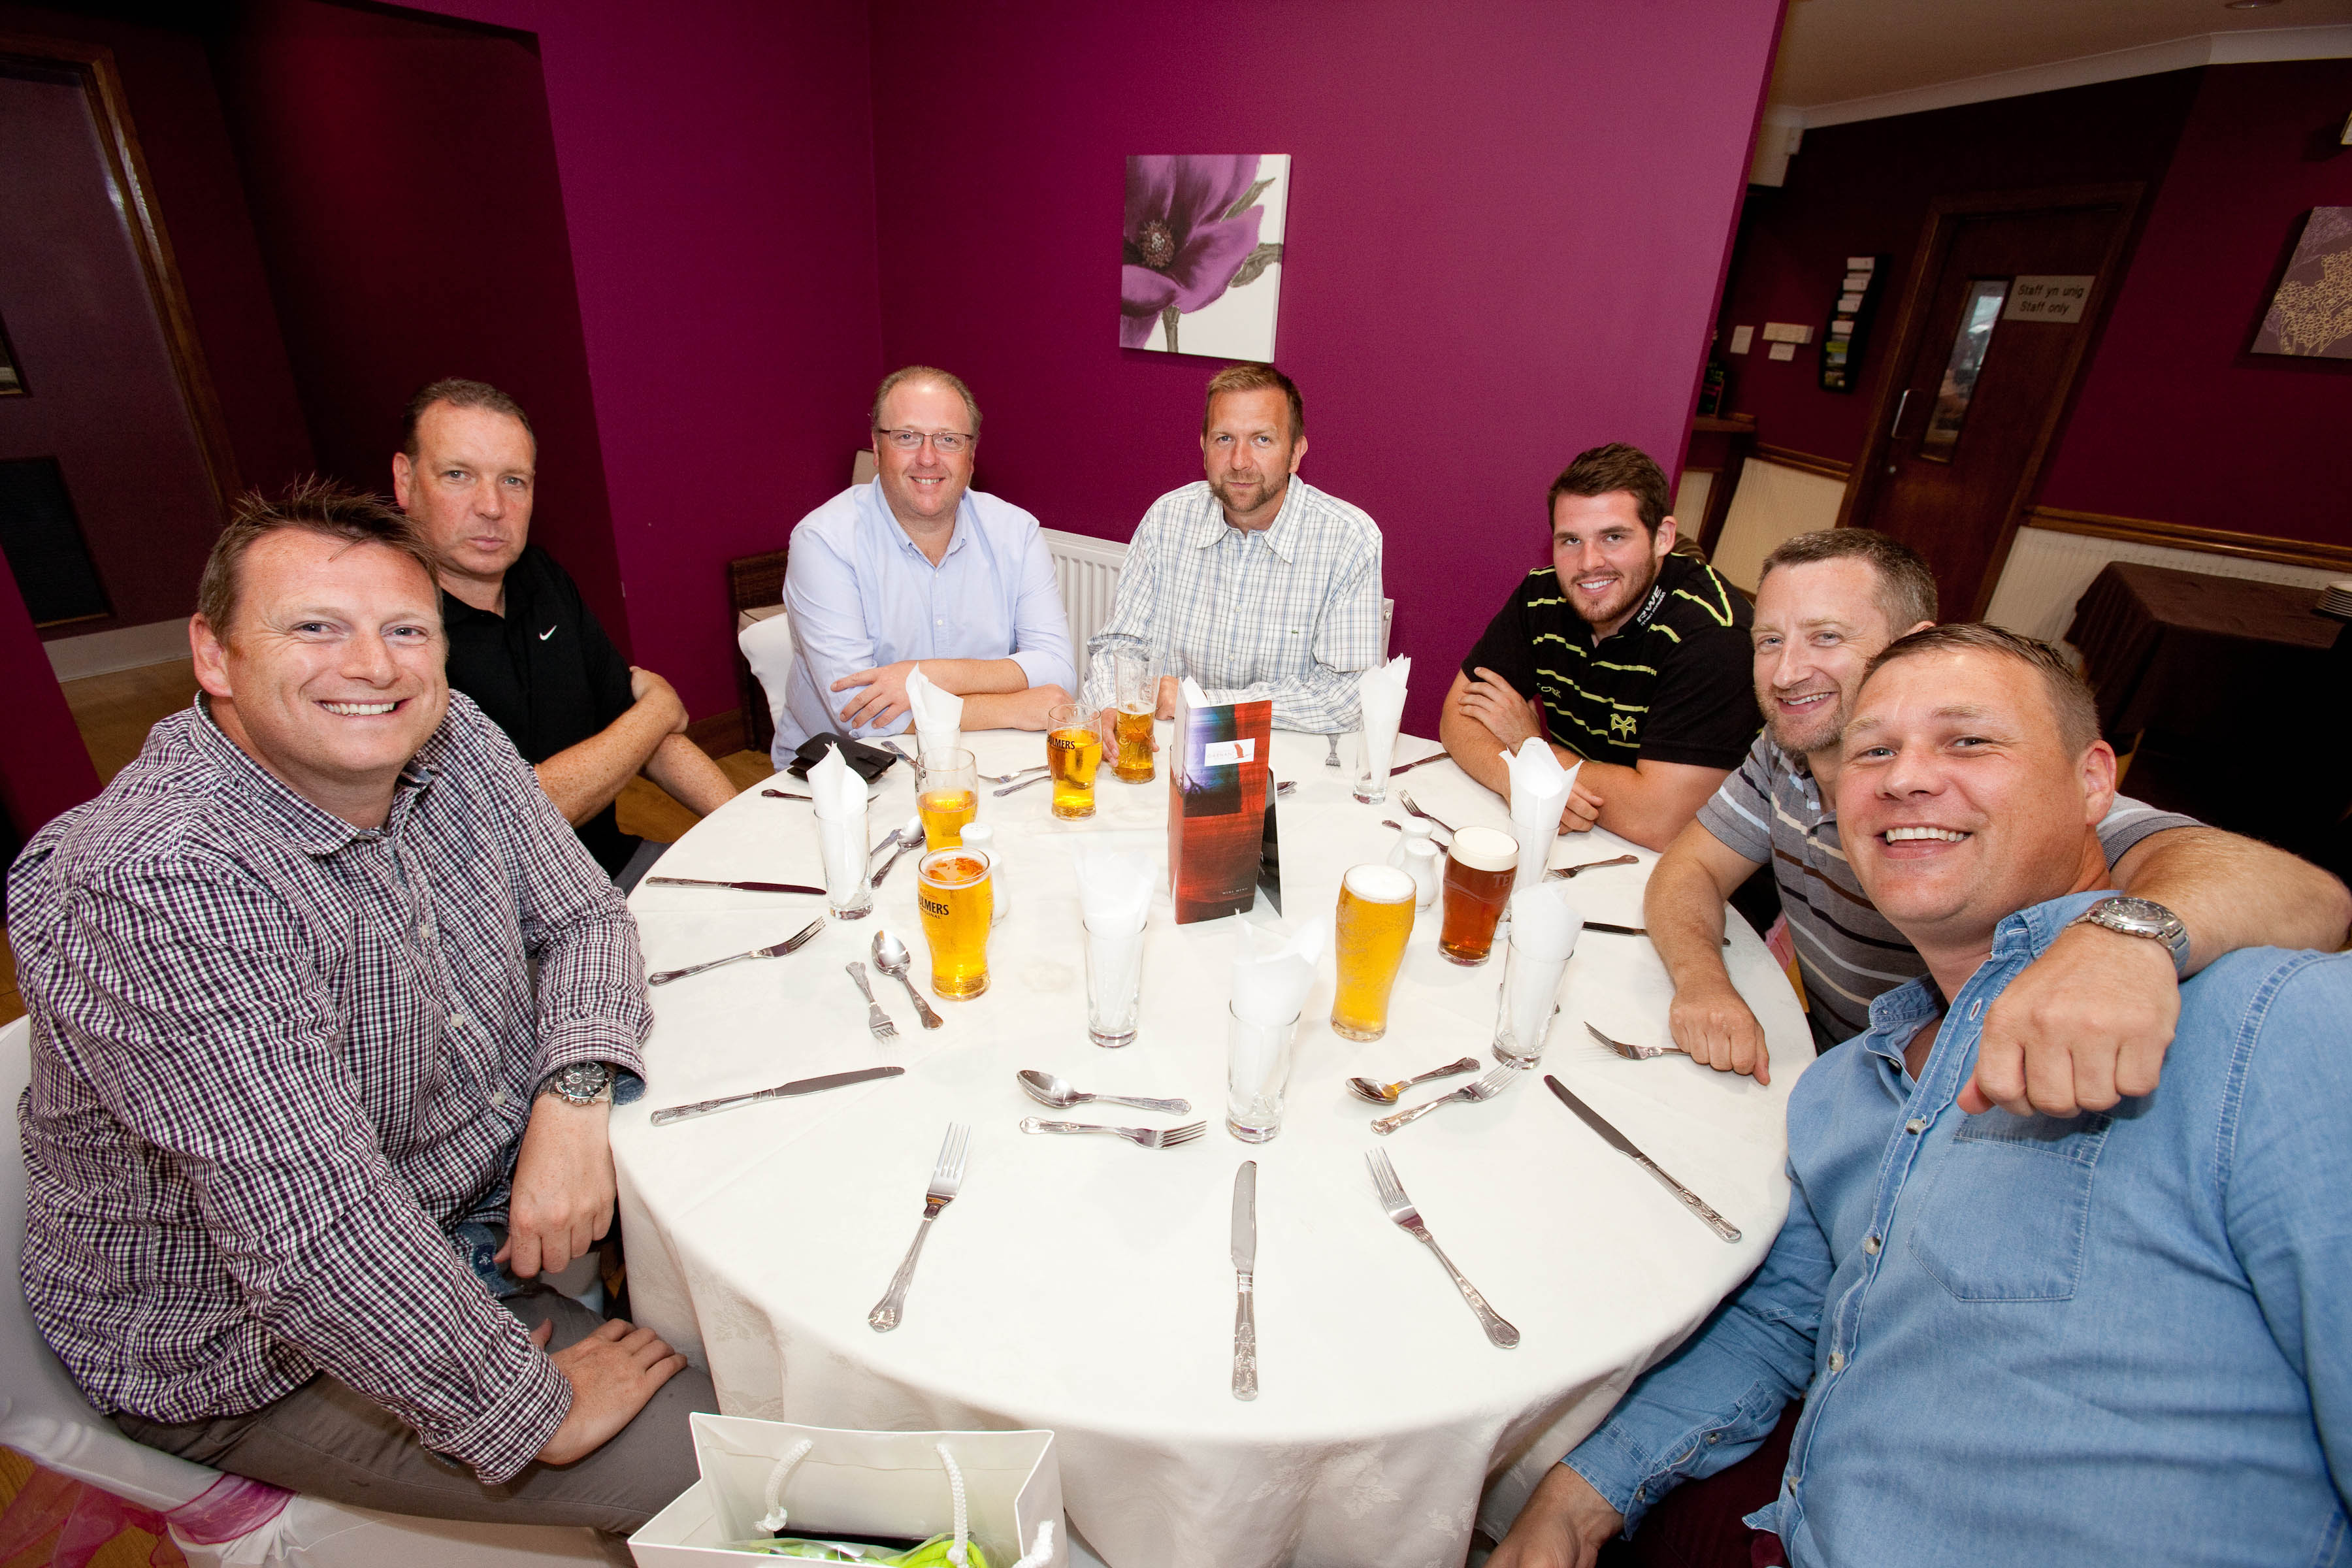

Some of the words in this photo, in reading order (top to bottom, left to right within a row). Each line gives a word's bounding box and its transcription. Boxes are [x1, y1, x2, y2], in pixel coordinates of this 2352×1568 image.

[2017, 284, 2044, 296] Staff
[2044, 287, 2060, 299] yn
[2063, 285, 2084, 299] unig
[2019, 301, 2046, 312] Staff
[2048, 302, 2070, 316] only
[1636, 585, 1662, 623] RWE
[919, 894, 949, 915] ULMERS
